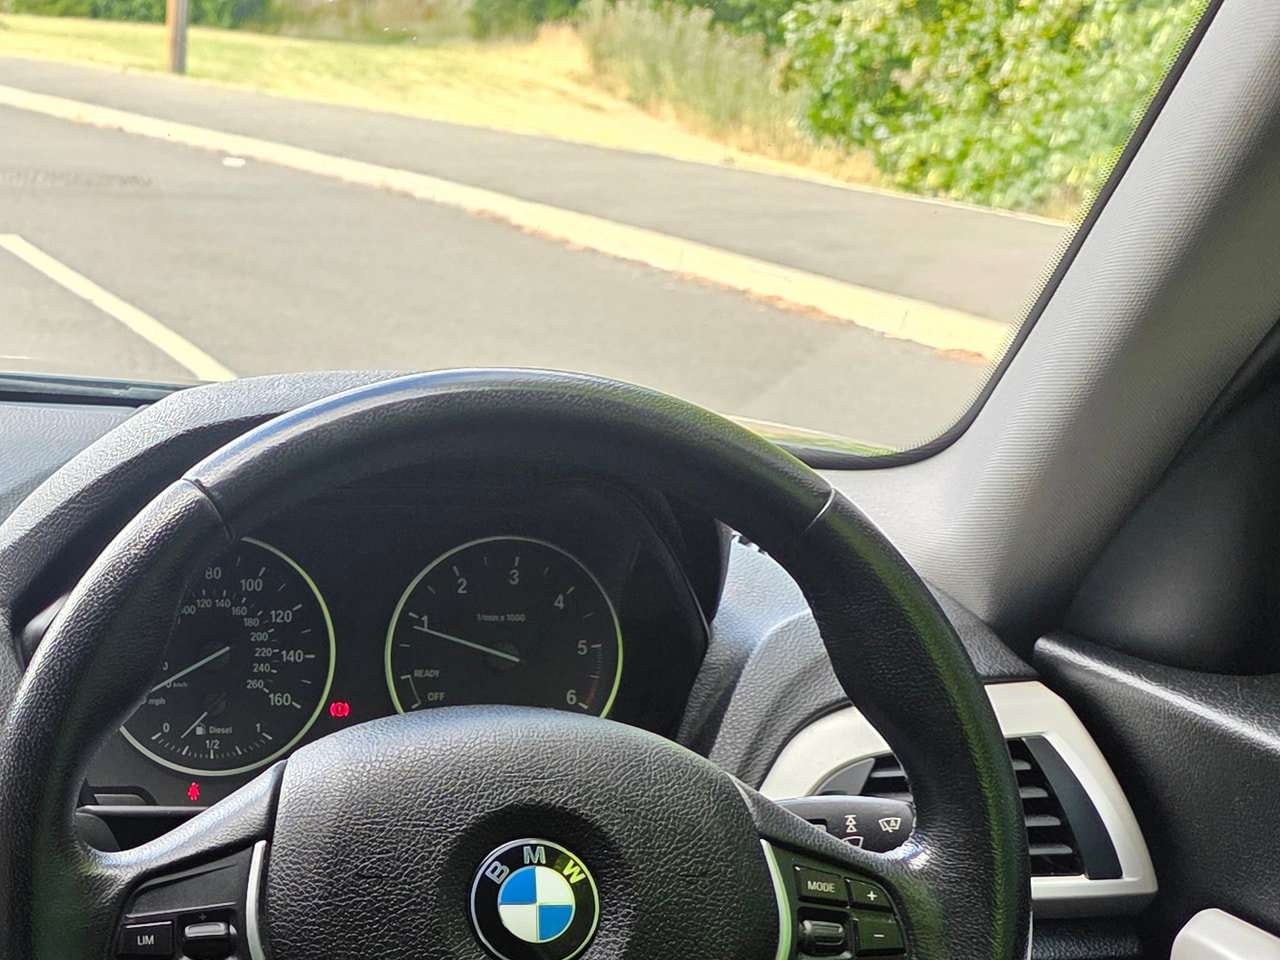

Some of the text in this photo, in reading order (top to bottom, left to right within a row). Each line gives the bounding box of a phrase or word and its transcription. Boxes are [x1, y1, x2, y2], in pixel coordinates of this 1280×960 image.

[205, 566, 222, 580] 80
[509, 570, 520, 584] 3
[240, 578, 263, 592] 100
[457, 578, 468, 594] 2
[196, 598, 212, 608] 120
[554, 594, 564, 610] 4
[270, 610, 293, 623] 120
[421, 615, 428, 630] 1
[250, 632, 268, 642] 200
[255, 648, 272, 657] 220
[577, 640, 588, 654] 5
[281, 650, 304, 663] 140
[253, 664, 270, 672] 240
[246, 680, 264, 689] 260
[269, 693, 292, 706] 160
[427, 692, 446, 700] OFF
[566, 690, 577, 705] 6
[162, 722, 170, 733] 0
[205, 740, 220, 749] 1/2
[484, 846, 586, 885] BMW
[807, 880, 836, 894] MODE
[137, 935, 154, 946] LIM
